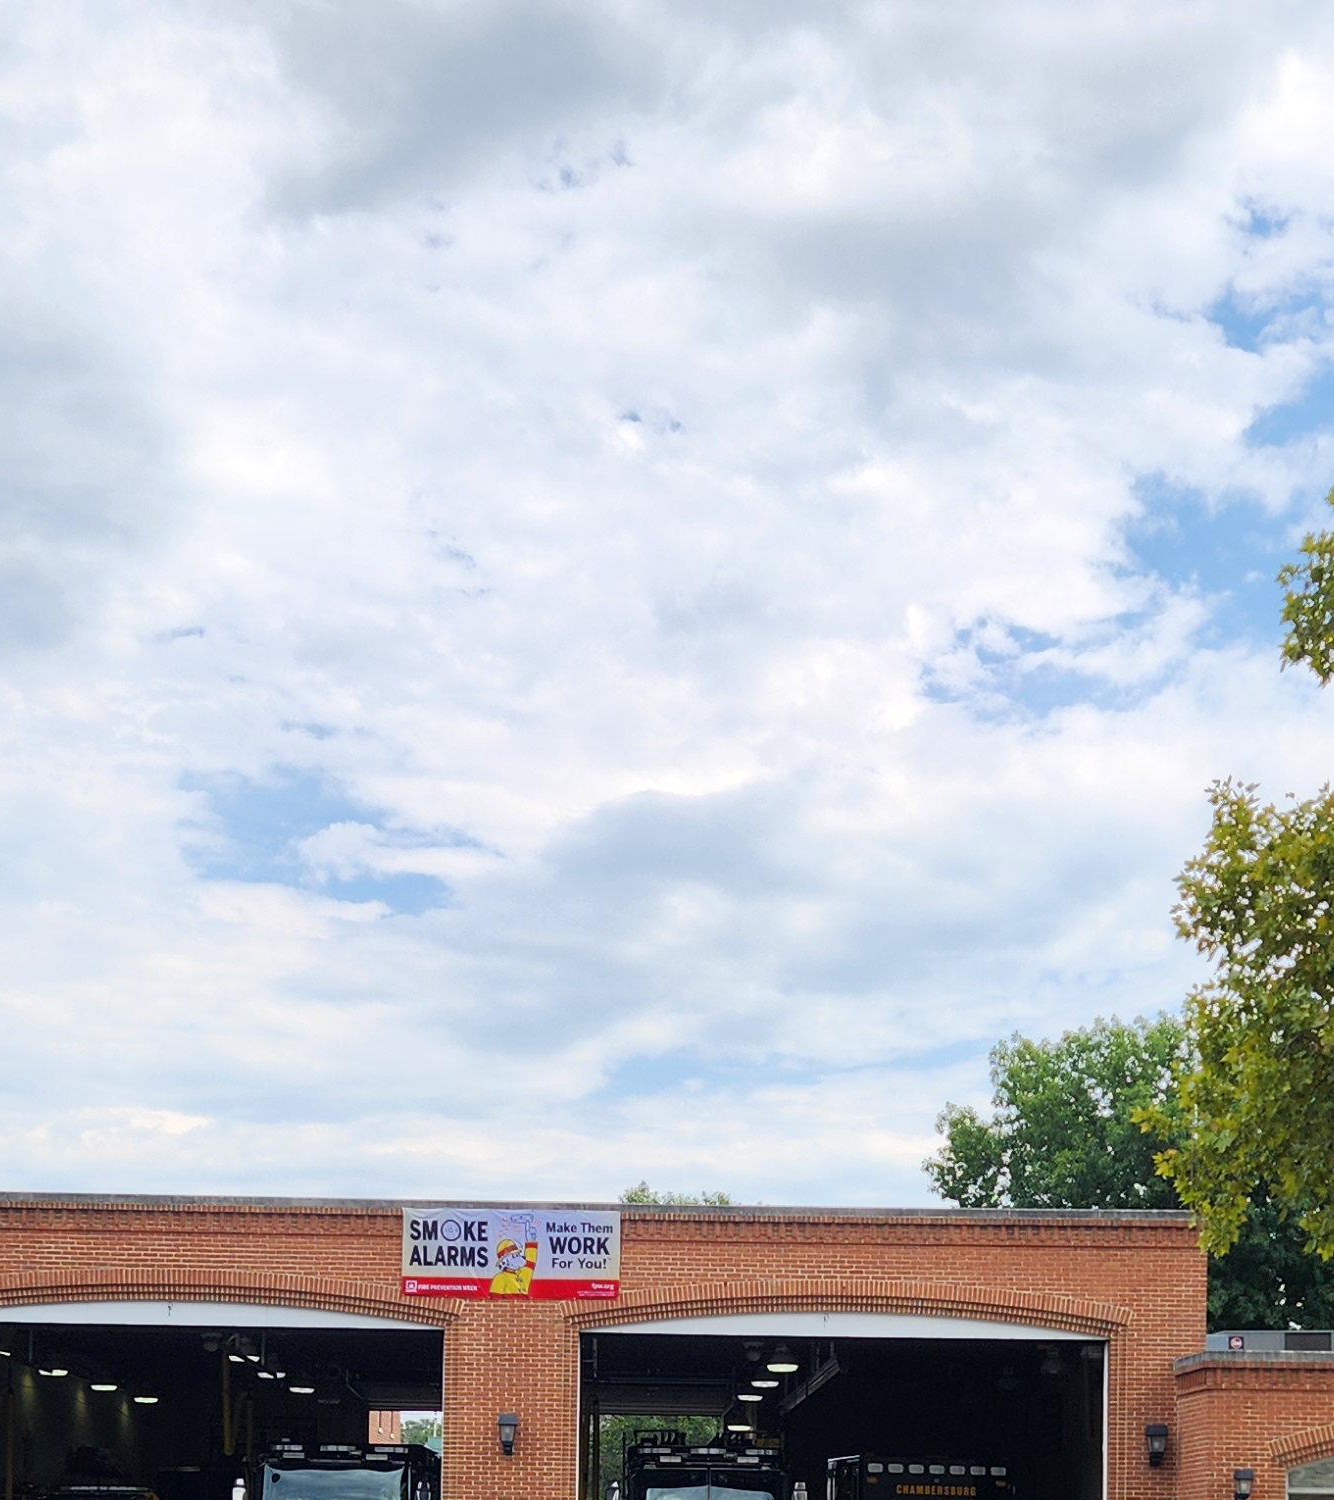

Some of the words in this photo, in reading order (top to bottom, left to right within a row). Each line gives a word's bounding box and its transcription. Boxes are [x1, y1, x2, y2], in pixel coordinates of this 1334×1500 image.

[409, 1219, 489, 1242] SMOKE
[546, 1222, 577, 1234] Make
[581, 1222, 613, 1234] Them
[549, 1236, 610, 1256] WORK
[409, 1245, 489, 1268] ALARMS
[552, 1257, 574, 1269] For
[577, 1257, 607, 1269] You!
[895, 1484, 977, 1497] CHAMBERSBURG
